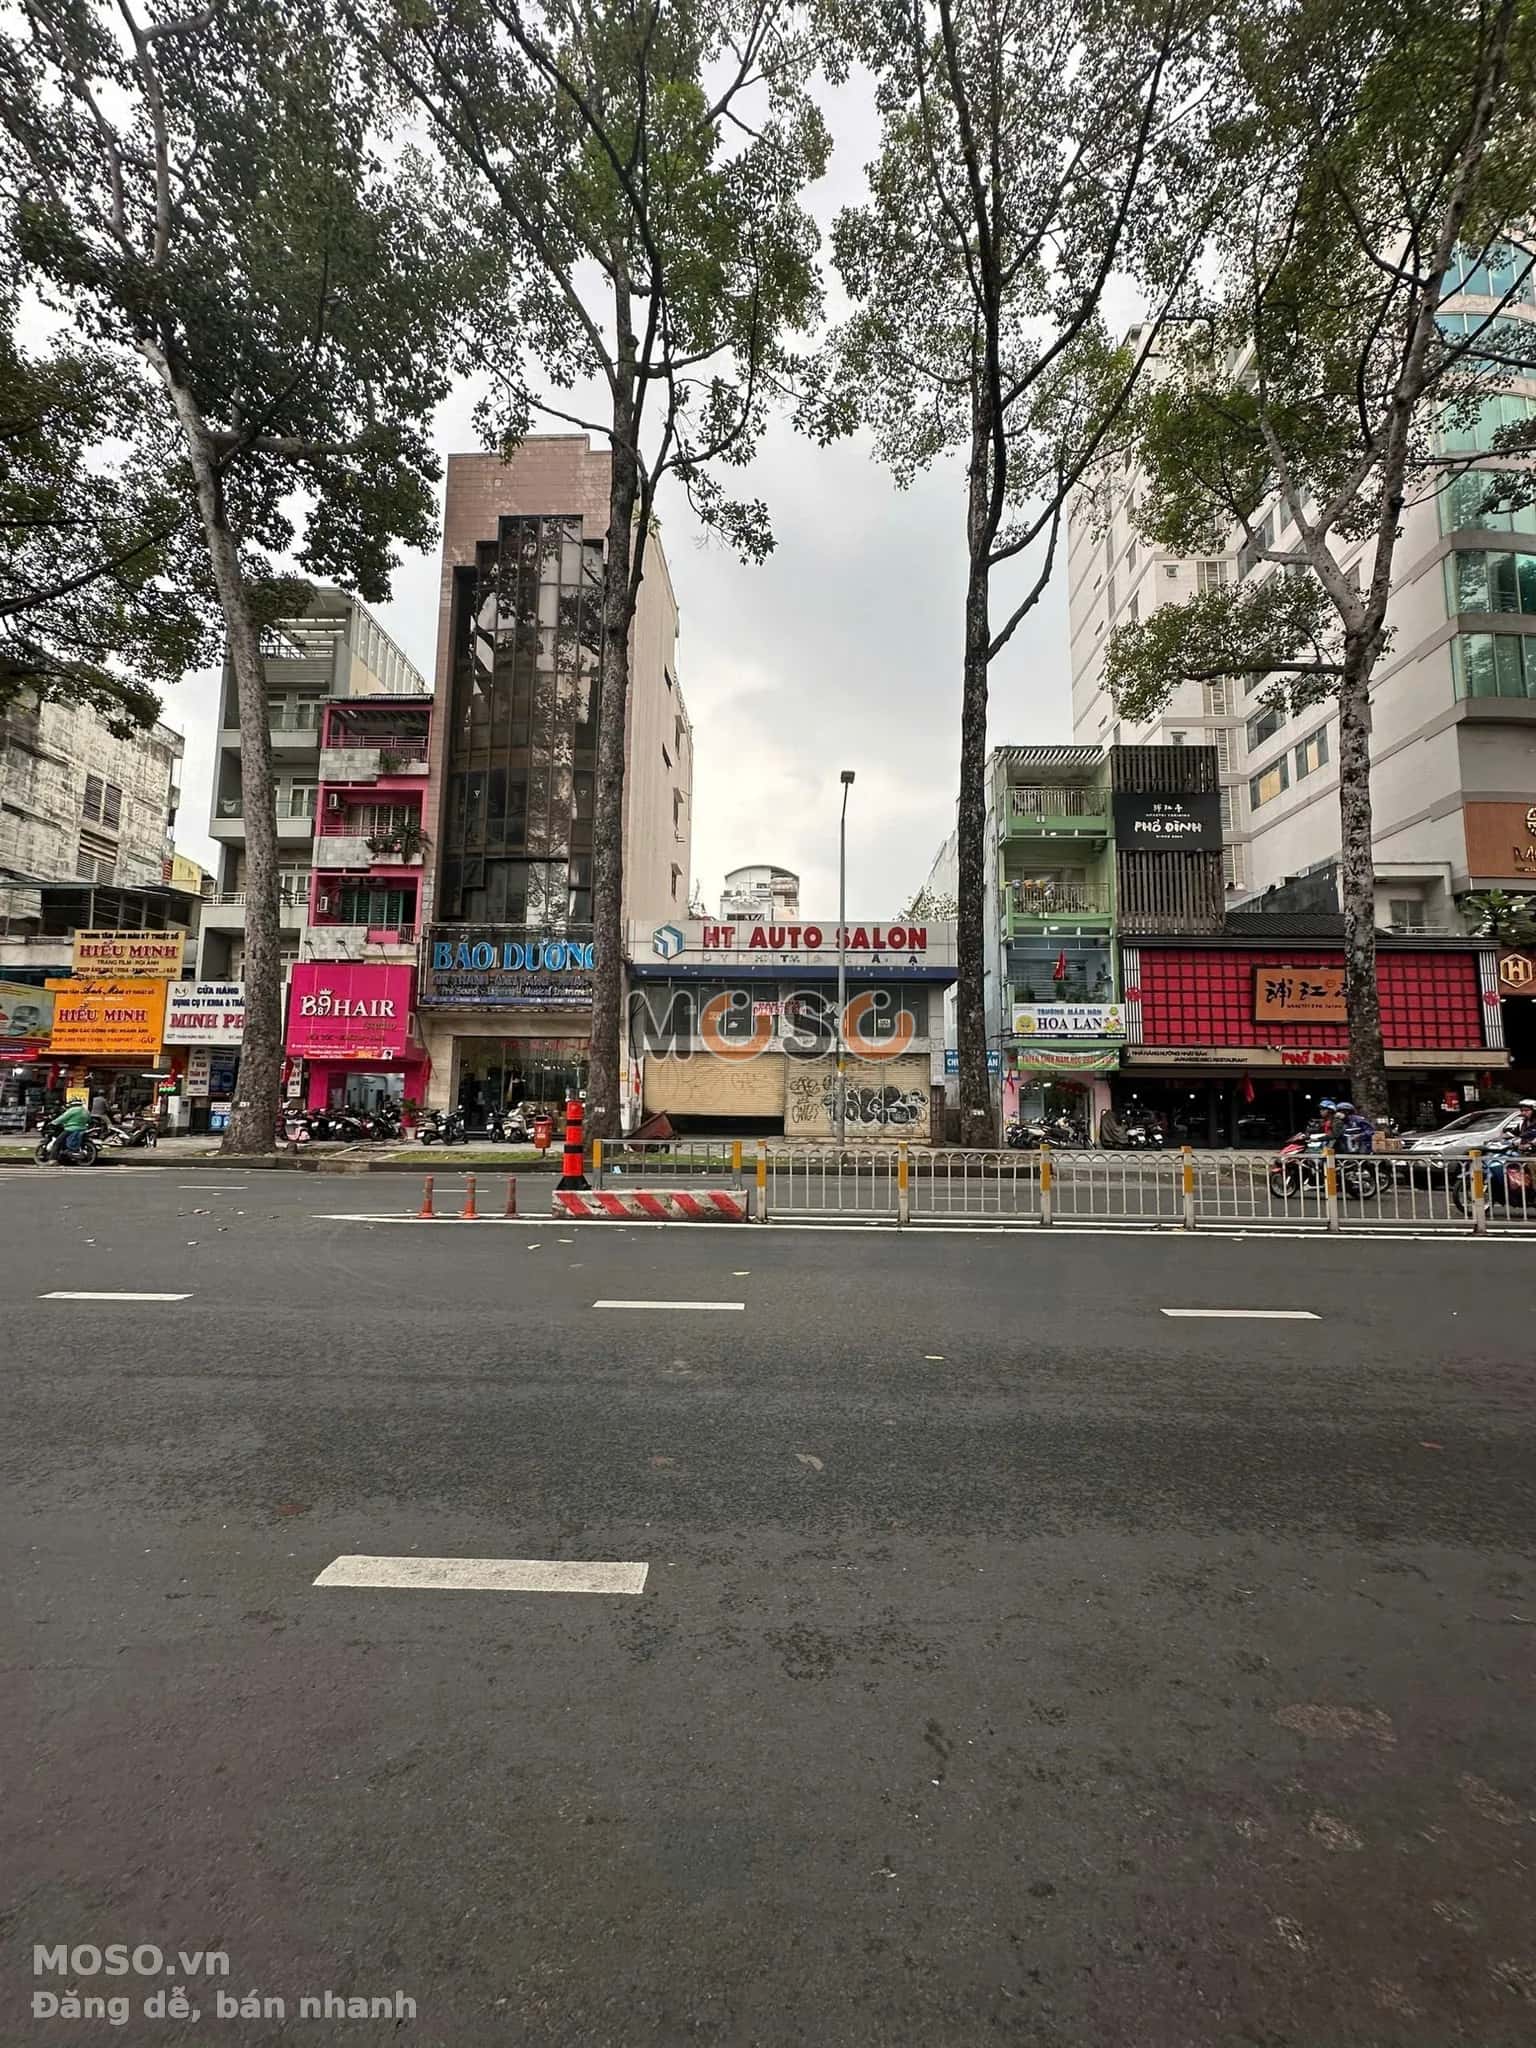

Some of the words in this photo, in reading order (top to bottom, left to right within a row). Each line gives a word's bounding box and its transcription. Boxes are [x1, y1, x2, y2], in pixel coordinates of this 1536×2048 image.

[703, 926, 736, 948] HT
[749, 926, 822, 949] AUTO
[836, 926, 927, 950] SALON
[129, 945, 178, 959] MINH
[433, 934, 494, 971] BẢO
[104, 1009, 147, 1022] MINH
[334, 1000, 396, 1017] HAIR
[169, 1013, 218, 1028] MINH
[222, 1013, 246, 1028] PH
[1037, 1017, 1068, 1031] HOA
[1074, 1017, 1103, 1031] LAN
